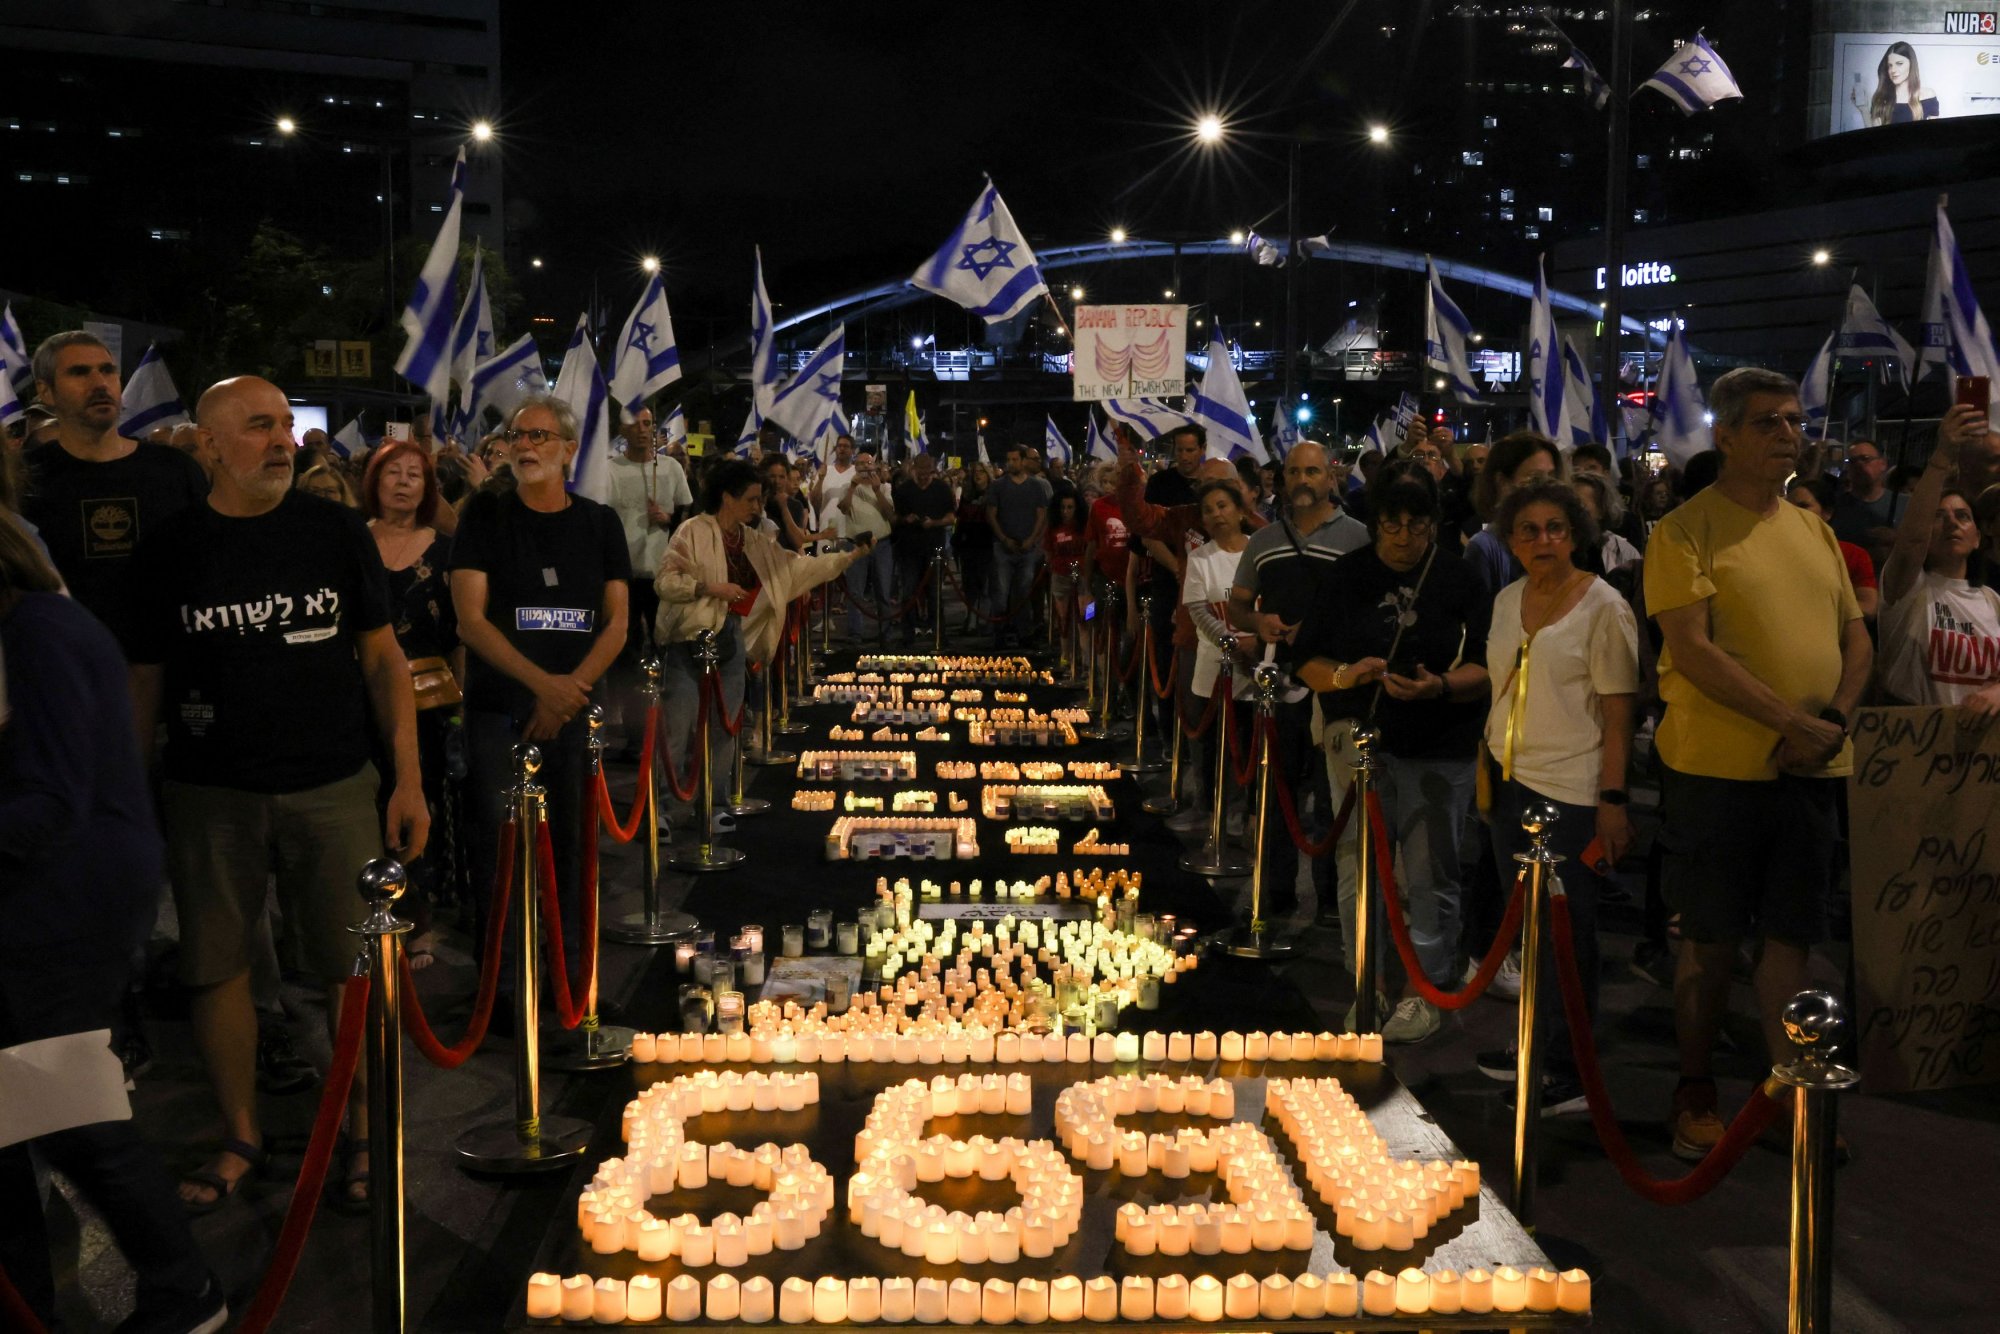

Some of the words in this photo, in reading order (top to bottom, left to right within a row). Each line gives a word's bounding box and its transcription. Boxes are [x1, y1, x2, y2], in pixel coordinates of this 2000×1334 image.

[1078, 385, 1096, 397] THE
[1102, 384, 1123, 397] NEW
[1132, 380, 1160, 395] JEWISH
[1162, 379, 1185, 394] STATE
[1857, 745, 1899, 786] על
[1874, 867, 1918, 911] על
